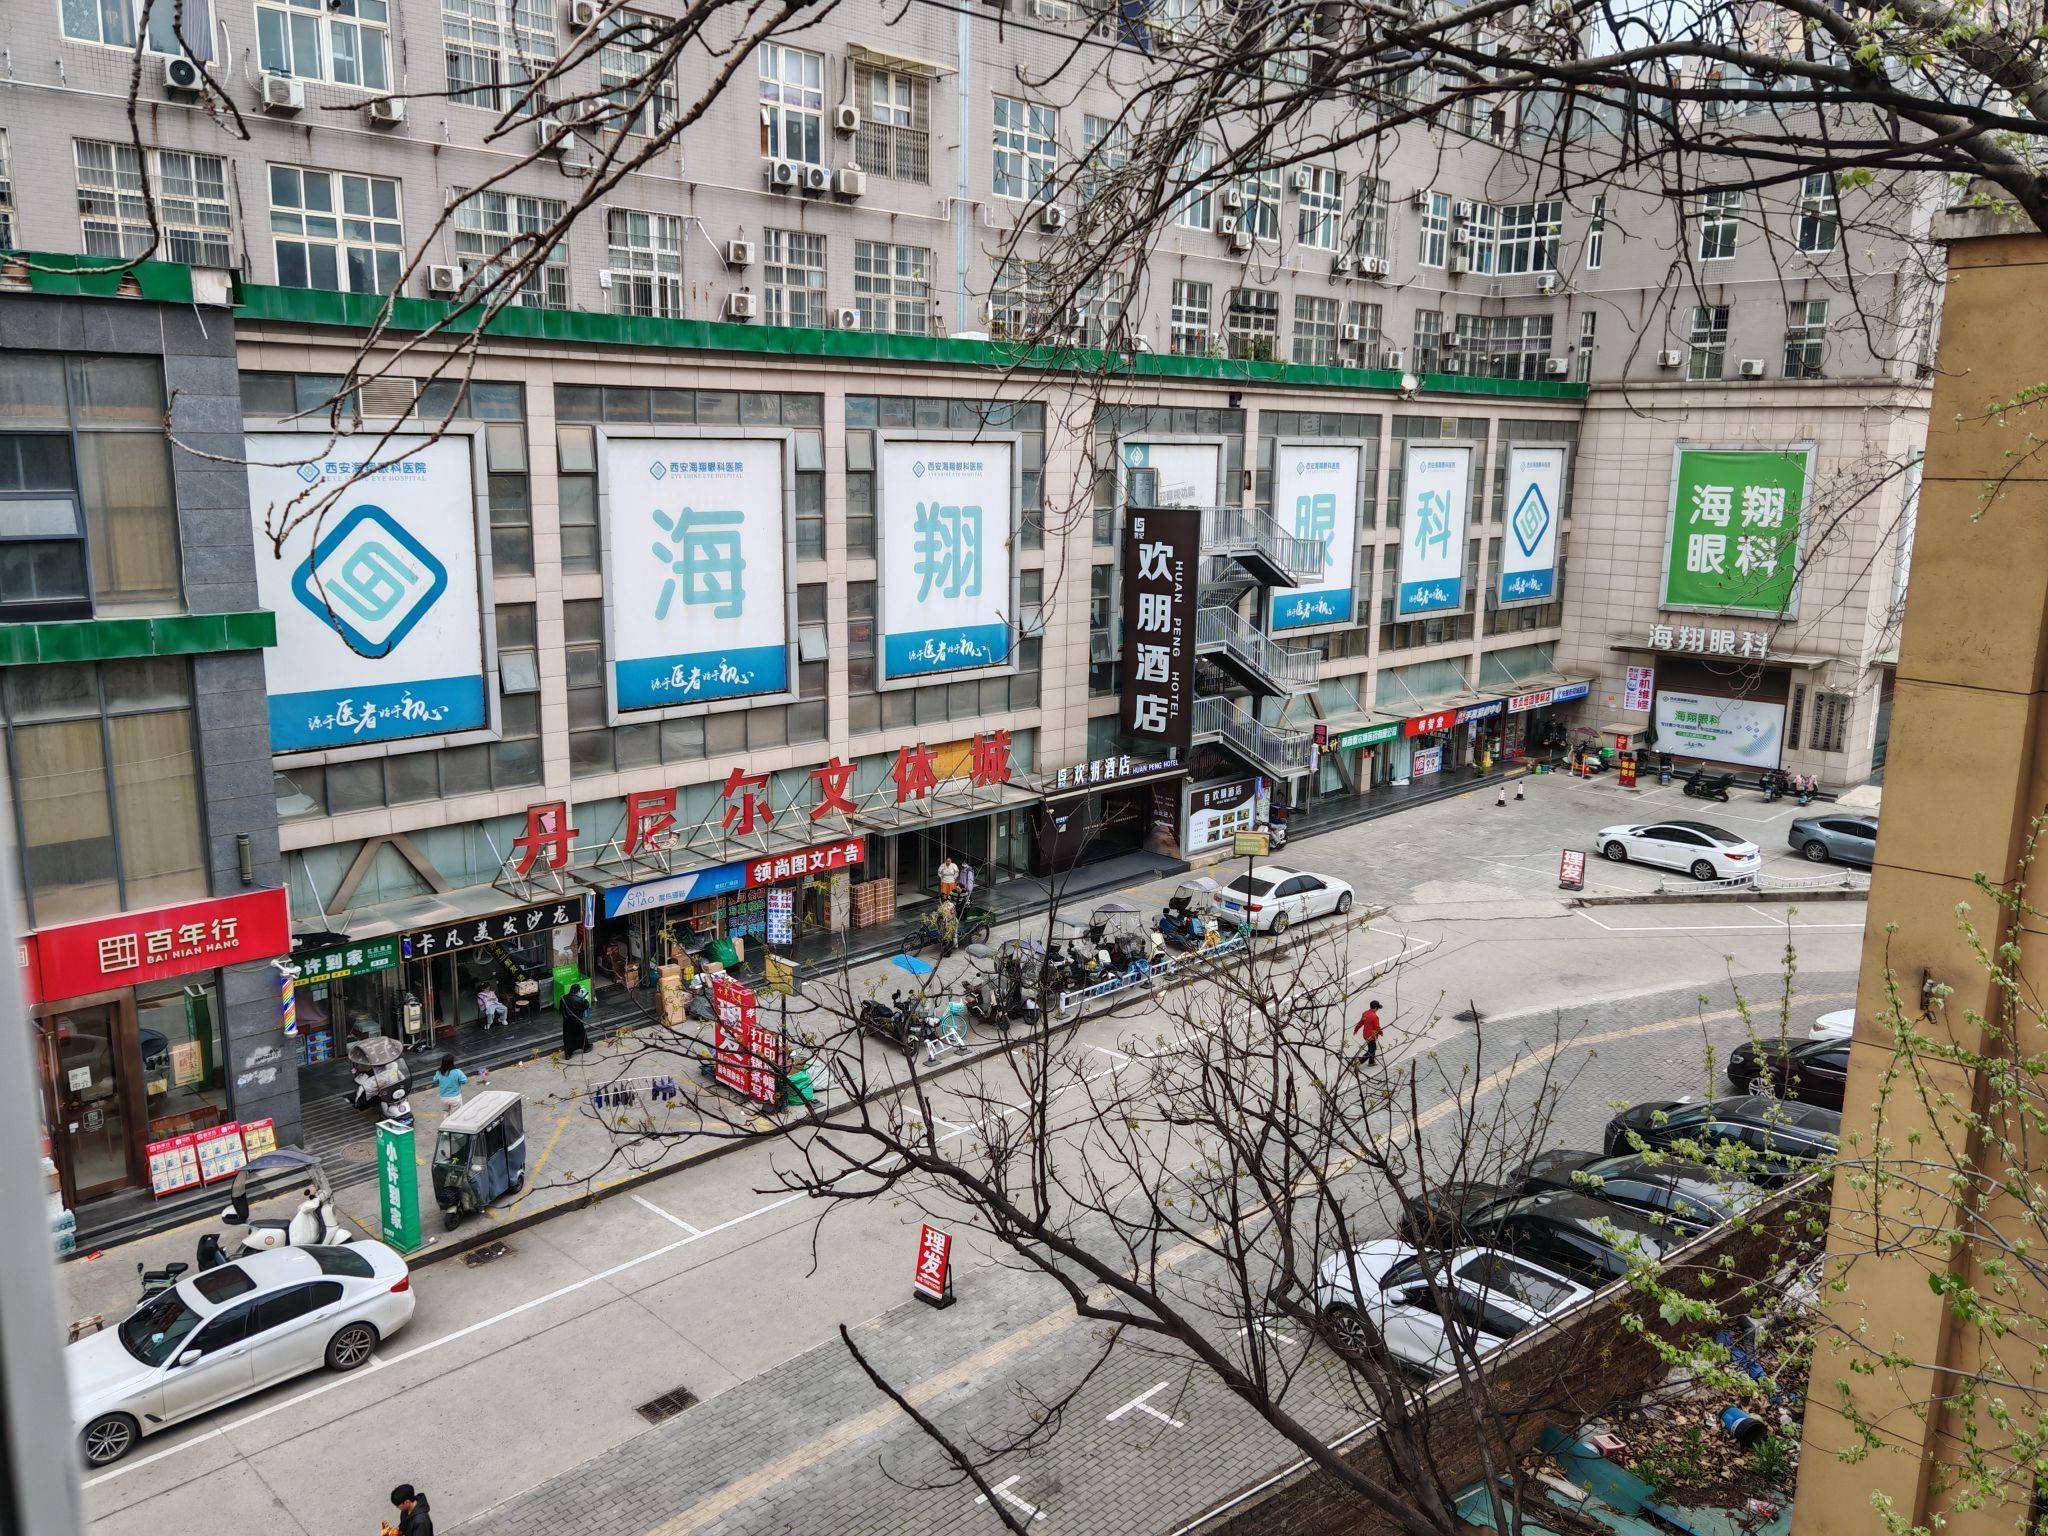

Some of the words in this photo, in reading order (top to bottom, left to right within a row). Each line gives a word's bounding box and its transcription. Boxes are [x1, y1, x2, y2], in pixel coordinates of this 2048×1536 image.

[670, 461, 743, 473] 西安海翔眼科医院
[1415, 490, 1452, 561] 科
[1689, 484, 1786, 528] 海翔
[914, 501, 983, 603] 翔
[1295, 493, 1337, 571] 眼
[651, 506, 746, 621] 海
[1686, 534, 1779, 577] 眼科
[1174, 560, 1184, 603] HUAN
[1133, 541, 1174, 734] 欢朋酒店
[1173, 617, 1182, 658] PENG
[1648, 623, 1771, 659] 海翔眼科
[651, 657, 754, 695] 源于医者始于初心
[1170, 671, 1180, 719] HOTEL
[1637, 668, 1652, 710] 手机维修
[307, 690, 449, 734] 源于医者始于初心
[1675, 710, 1720, 726] 海翔眼科
[1074, 754, 1131, 786] 欢朋酒店
[1132, 765, 1148, 774] HUAN
[1148, 762, 1162, 770] PENG
[1163, 759, 1179, 768] HOTEL
[512, 728, 1012, 877] 丹尼尔文体城
[754, 844, 860, 884] 领尚图文广告
[144, 917, 239, 953] 百年行
[417, 905, 570, 955] 卡凡美发沙龙
[146, 954, 169, 965] BAI
[172, 947, 202, 960] NIAN
[206, 938, 240, 952] HANG
[296, 949, 363, 979] 许到家
[750, 1028, 776, 1047] 打印
[750, 1071, 776, 1091] 条幅
[920, 1227, 946, 1279] 理发
